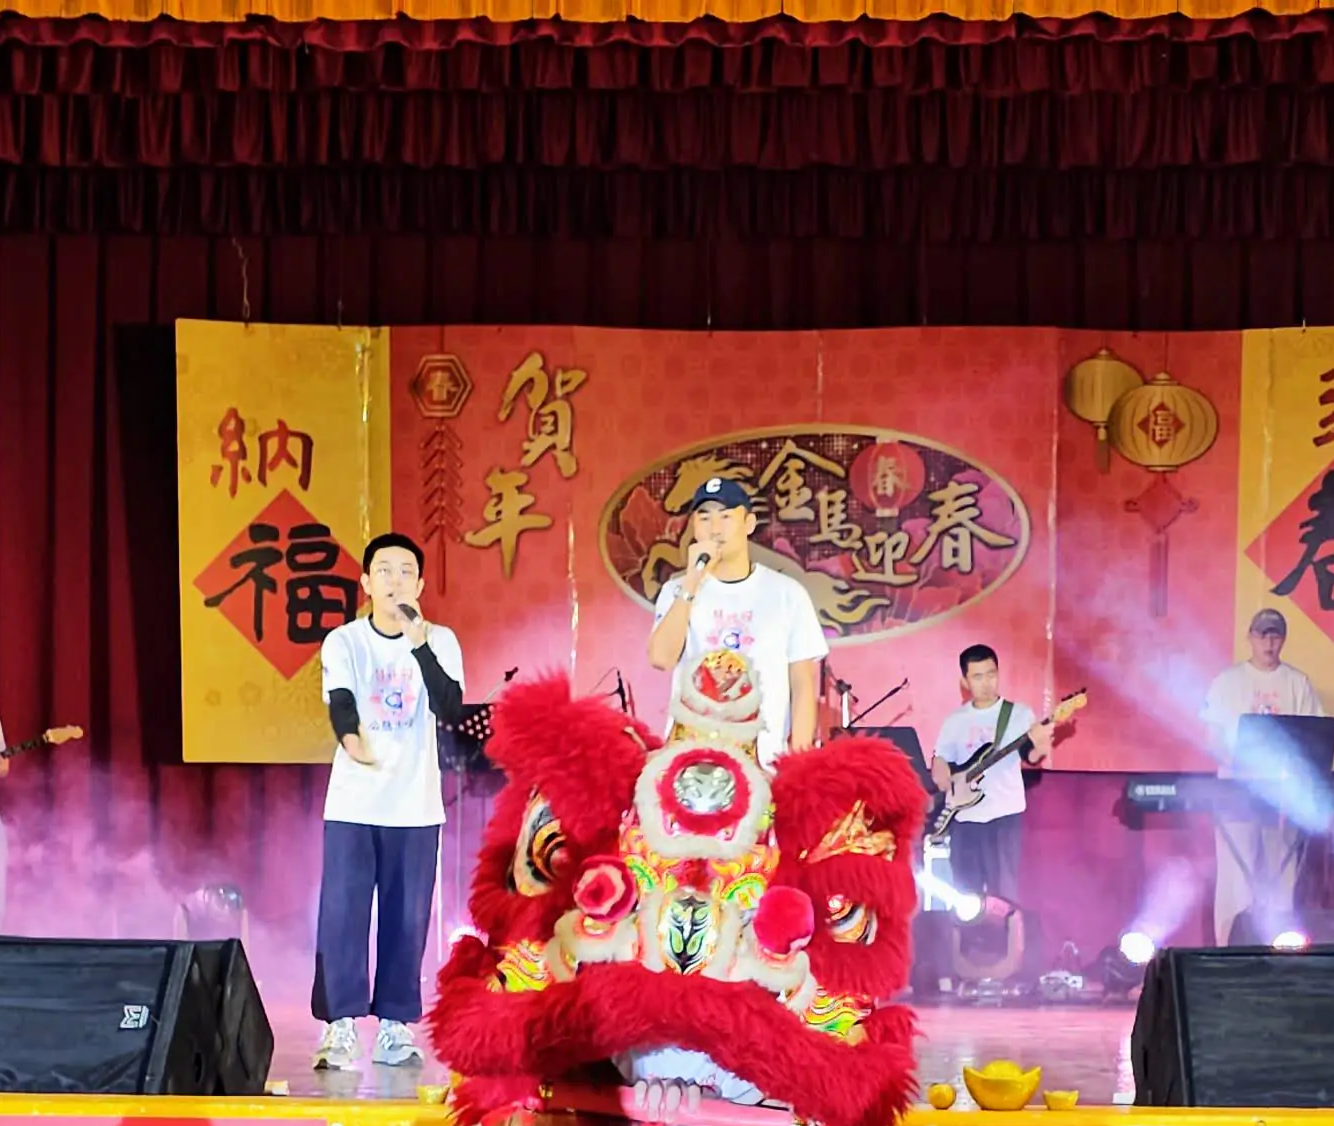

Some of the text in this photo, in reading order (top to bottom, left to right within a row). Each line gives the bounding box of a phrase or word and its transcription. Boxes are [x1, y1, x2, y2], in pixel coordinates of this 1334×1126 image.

[204, 407, 359, 644] 納福
[464, 352, 588, 580] 賀年
[759, 439, 1016, 588] 金馬迎春
